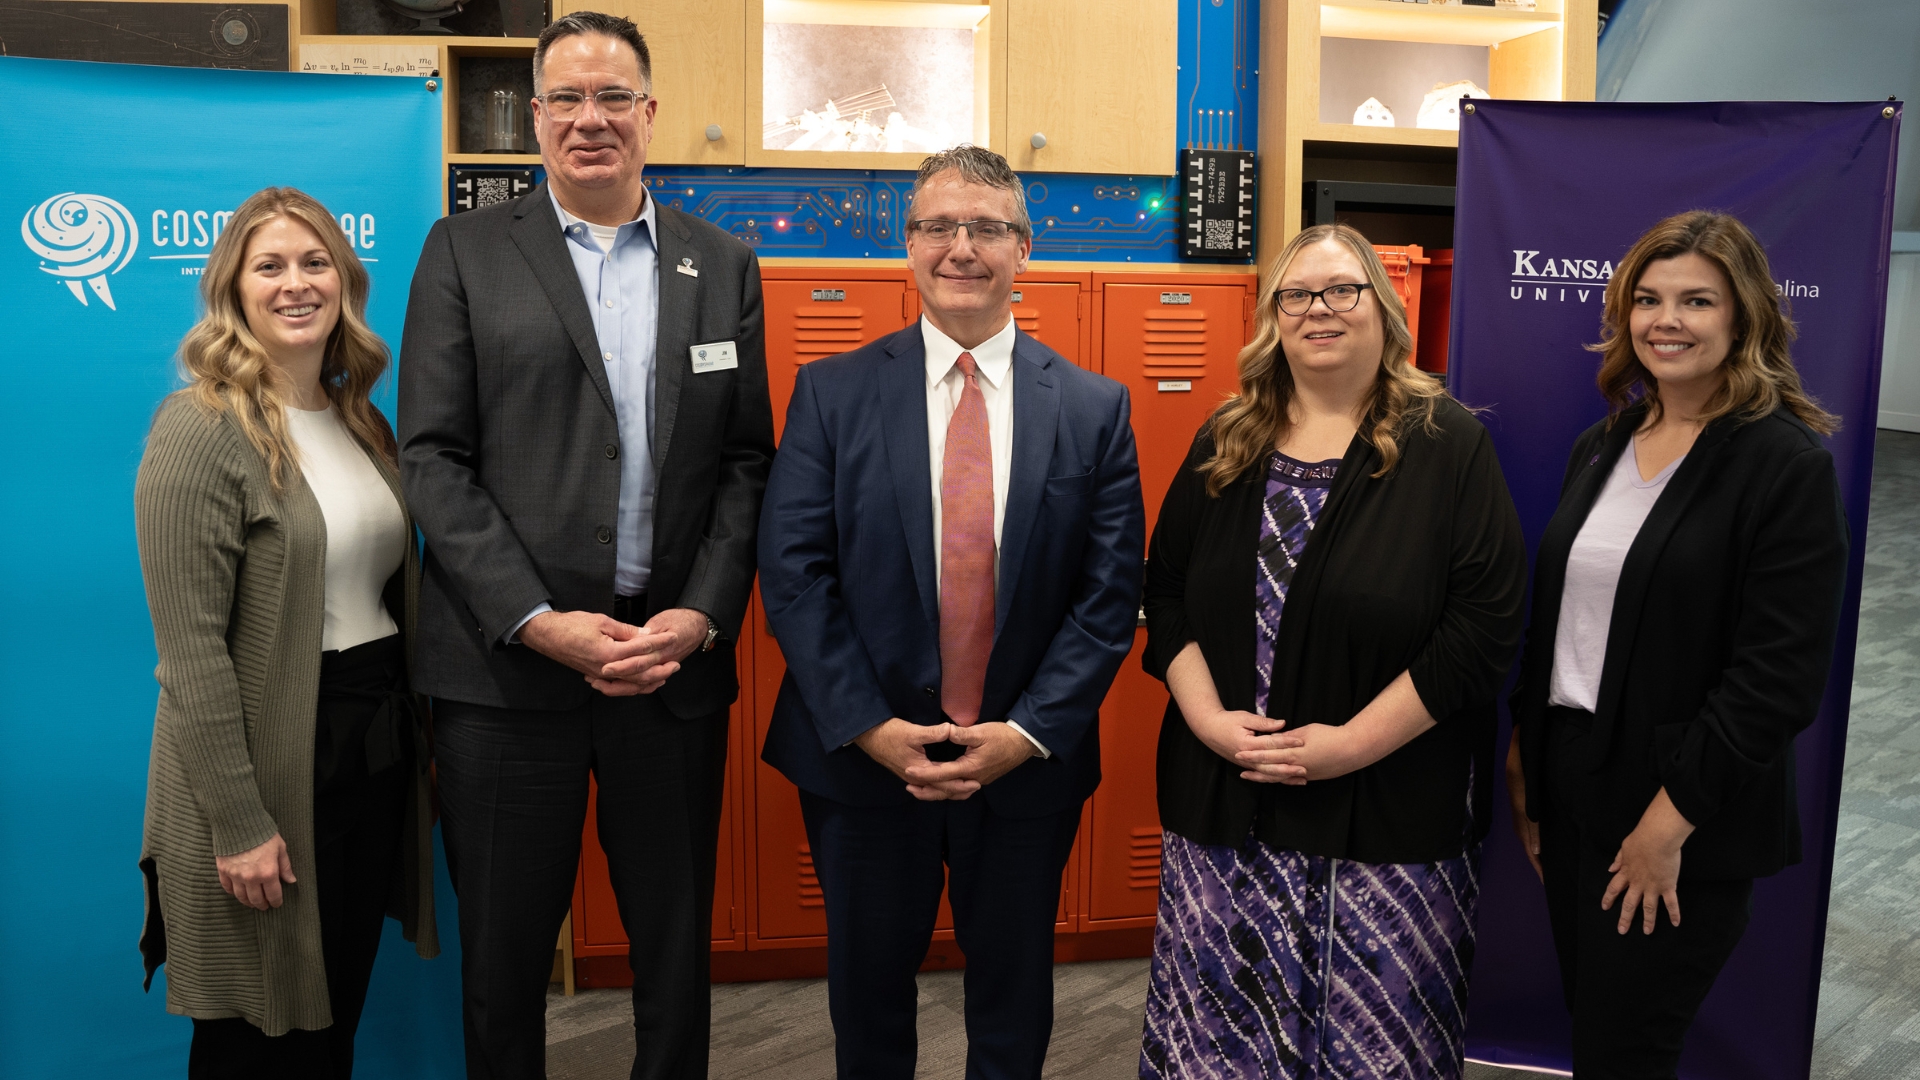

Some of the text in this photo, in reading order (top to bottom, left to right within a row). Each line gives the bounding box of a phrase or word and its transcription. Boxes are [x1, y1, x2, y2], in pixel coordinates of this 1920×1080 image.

[1511, 250, 1820, 298] KANSA alina
[1510, 286, 1607, 304] UNIV
